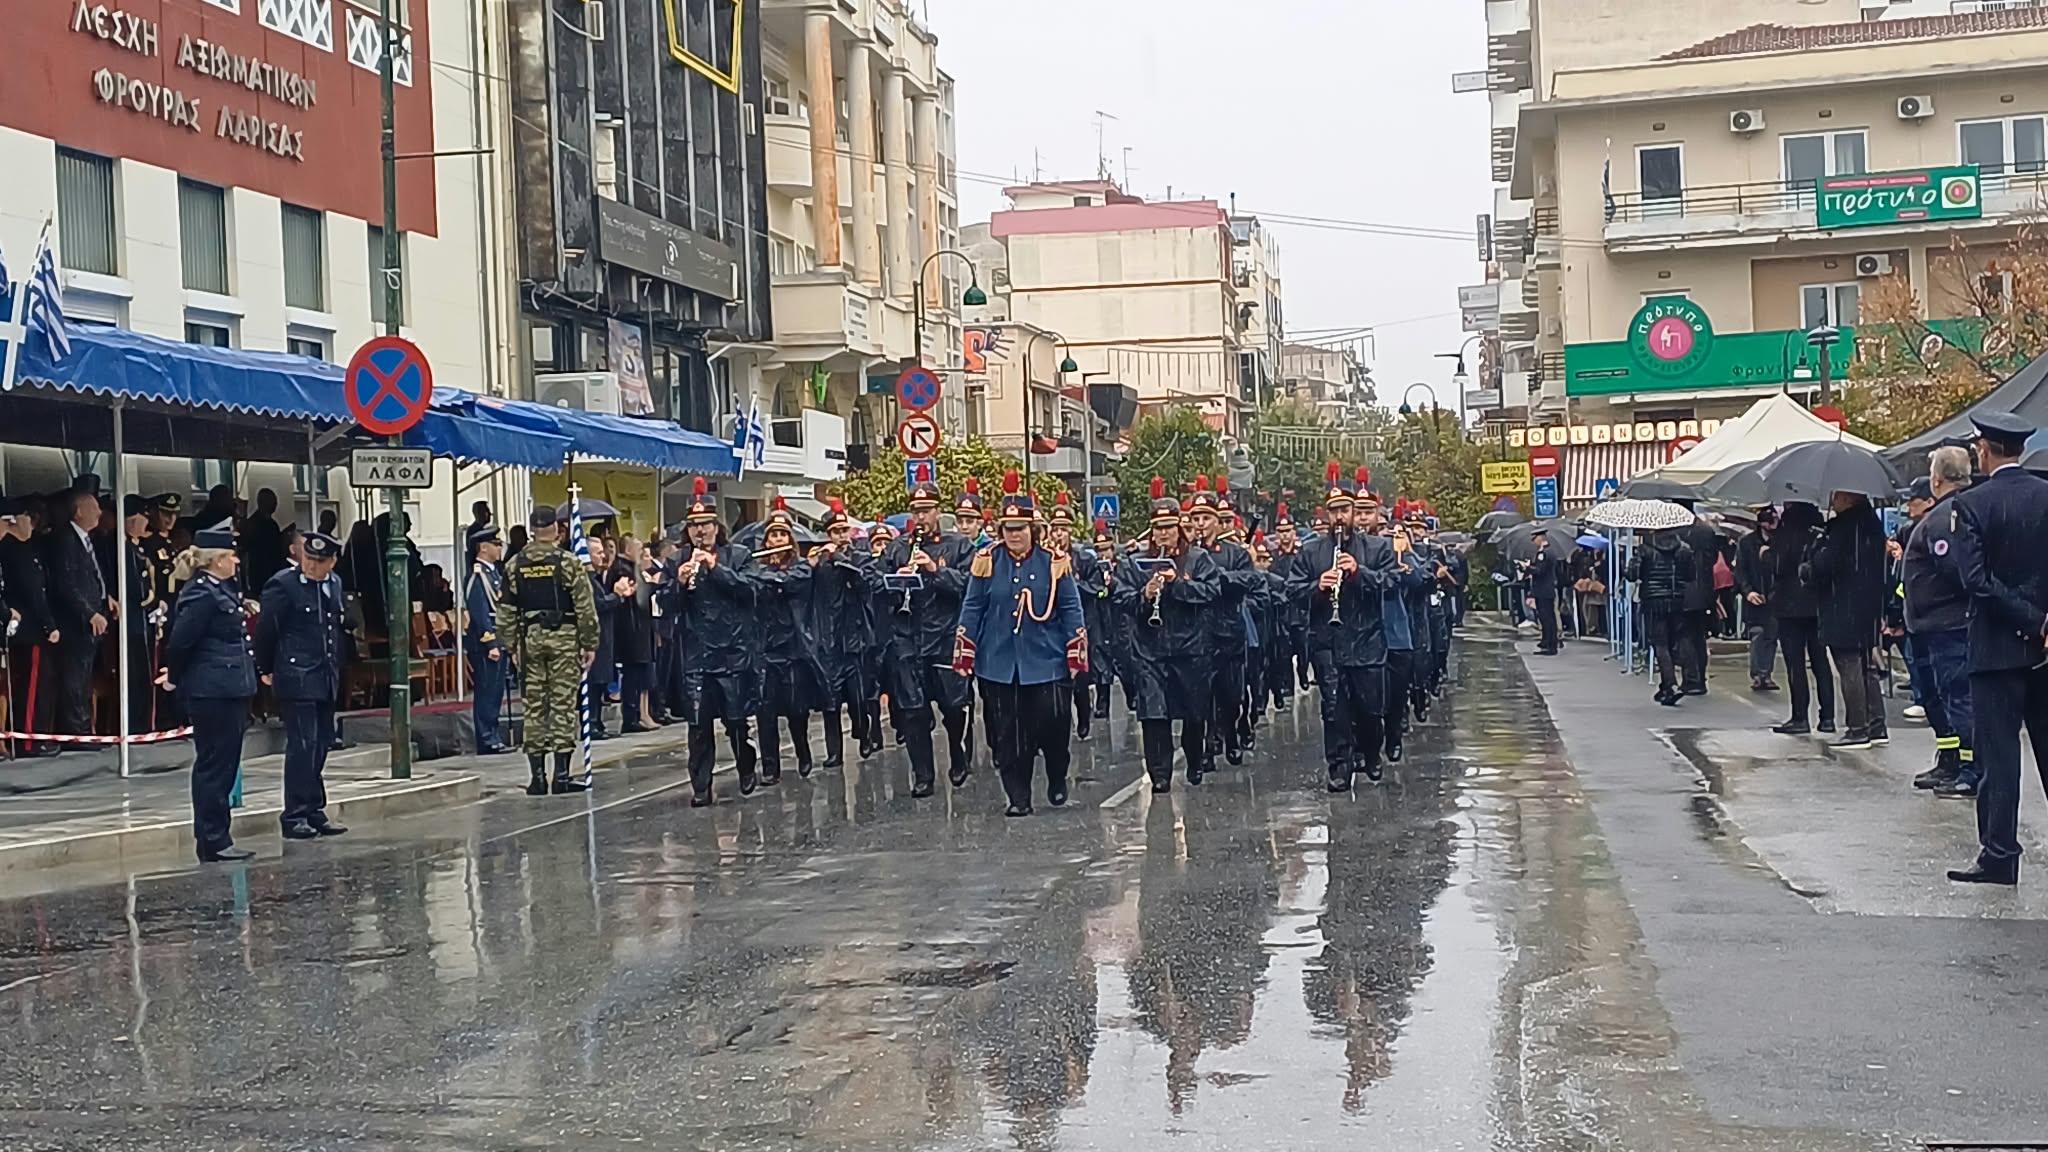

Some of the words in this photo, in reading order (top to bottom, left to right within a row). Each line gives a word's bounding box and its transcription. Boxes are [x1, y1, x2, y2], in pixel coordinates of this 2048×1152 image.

[73, 0, 158, 57] ΛΕΣΧΗ
[178, 33, 317, 111] ΑΞΙΩΜΑΤΙΚΩΝ
[94, 67, 201, 133] ΦΡΟΥΡΑΣ
[217, 105, 304, 162] ΛΑΡΙΣΑΣ
